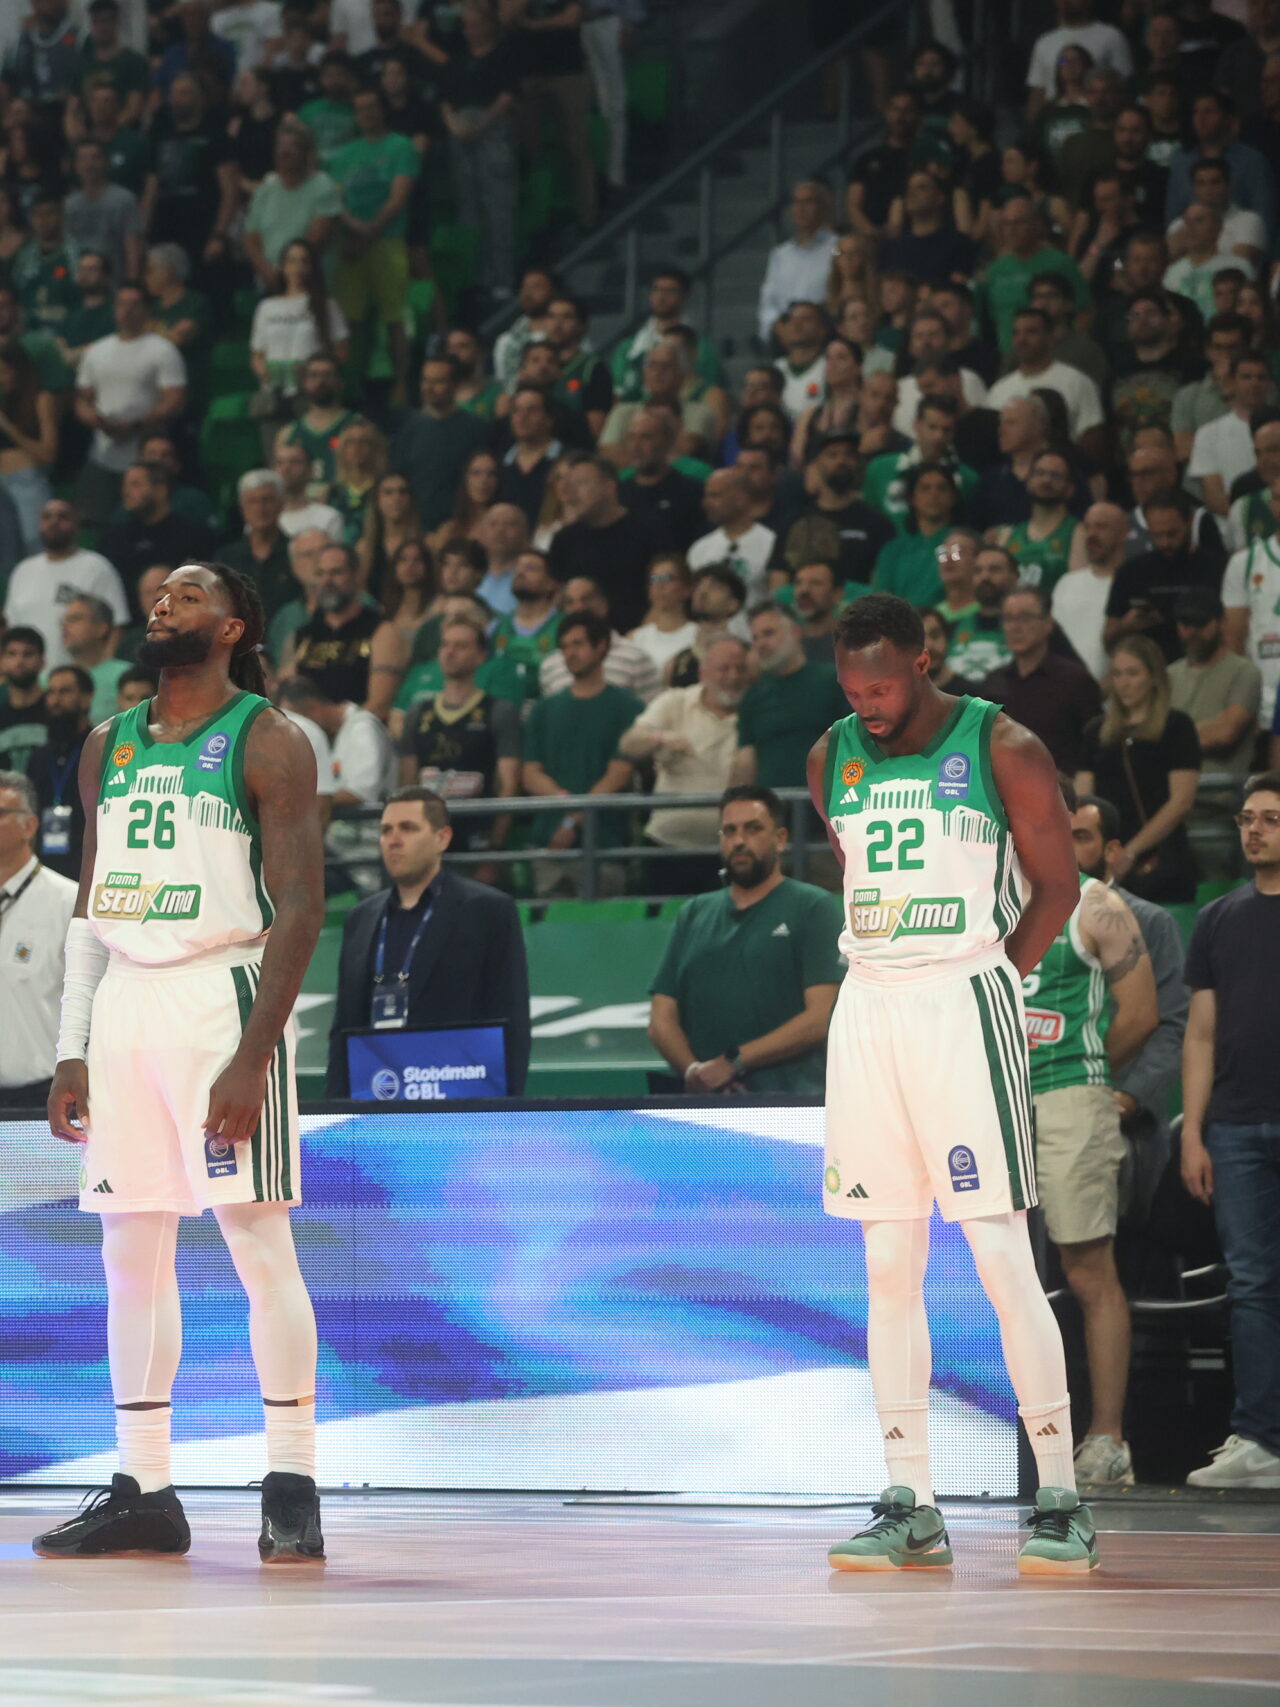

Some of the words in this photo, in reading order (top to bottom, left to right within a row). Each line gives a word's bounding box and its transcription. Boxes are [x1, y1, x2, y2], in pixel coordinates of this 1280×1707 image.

[127, 799, 175, 850] 26
[866, 818, 924, 873] 22
[107, 873, 139, 887] pame
[854, 890, 878, 903] pame
[404, 1081, 446, 1100] GBL
